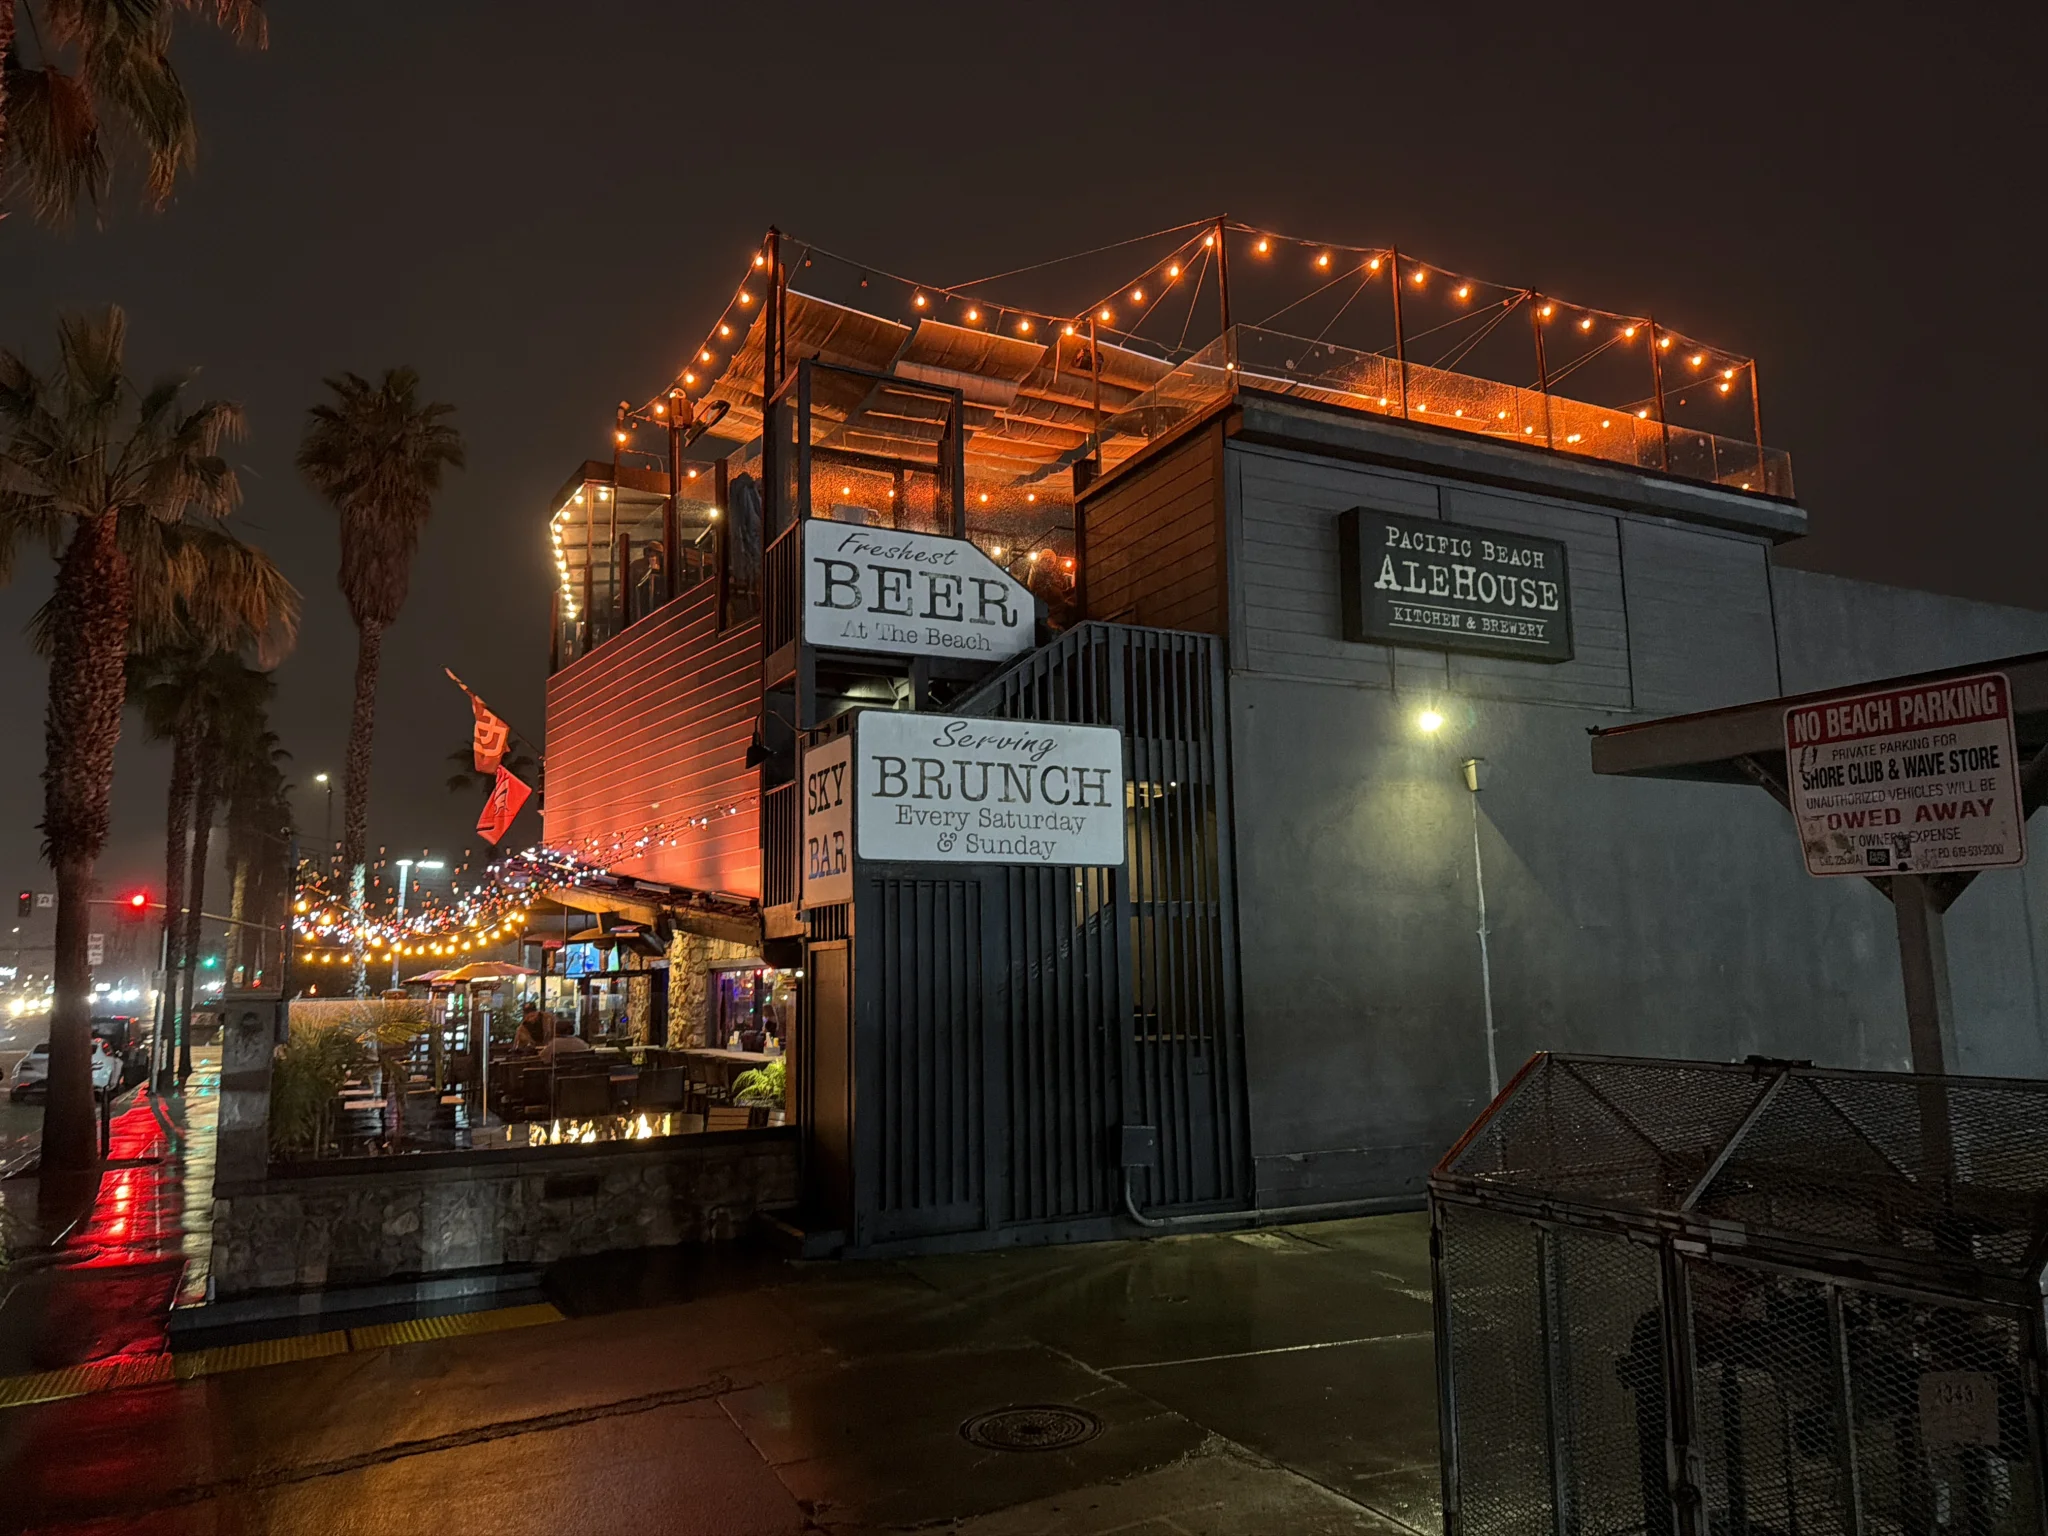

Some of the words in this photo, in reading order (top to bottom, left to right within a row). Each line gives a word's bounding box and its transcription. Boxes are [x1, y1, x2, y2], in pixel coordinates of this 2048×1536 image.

[837, 533, 958, 566] Freshest
[1385, 526, 1471, 558] PACIFIC
[1481, 540, 1545, 569] BEACH
[813, 557, 1018, 628] BEER
[1374, 554, 1559, 611] ALEHOUSE
[840, 619, 868, 639] At
[875, 622, 918, 644] The
[925, 629, 992, 652] Beach
[1393, 607, 1460, 628] KITCHEN
[1466, 616, 1476, 630] &
[1481, 617, 1545, 638] BREWERY
[1793, 711, 1821, 743] NO
[1826, 698, 1893, 739] BEACH
[1900, 681, 1999, 727] PARKING
[932, 720, 1058, 761] Serving
[1832, 743, 1877, 761] PRIVATE
[1879, 737, 1930, 755] PARKING
[1933, 733, 1957, 747] FOR
[871, 755, 1112, 808] BRUNCH
[1802, 765, 1845, 791] SHORE
[1848, 758, 1884, 785] CLUB
[1888, 757, 1899, 780] &
[1902, 751, 1945, 779] WAVE
[1950, 745, 2000, 773] STORE
[808, 761, 847, 816] SKY
[1806, 789, 1886, 810] UNAUTHORIZED
[1888, 784, 1943, 801] VEHICLES
[1946, 779, 1977, 796] WILL
[1980, 777, 1996, 792] BE
[895, 804, 970, 831] Every
[978, 807, 1087, 835] Saturday
[1915, 798, 1995, 823] AWAY
[936, 832, 957, 852] &
[966, 833, 1057, 860] Sunday
[1908, 826, 1961, 843] EXPENSE
[808, 830, 847, 880] BAR
